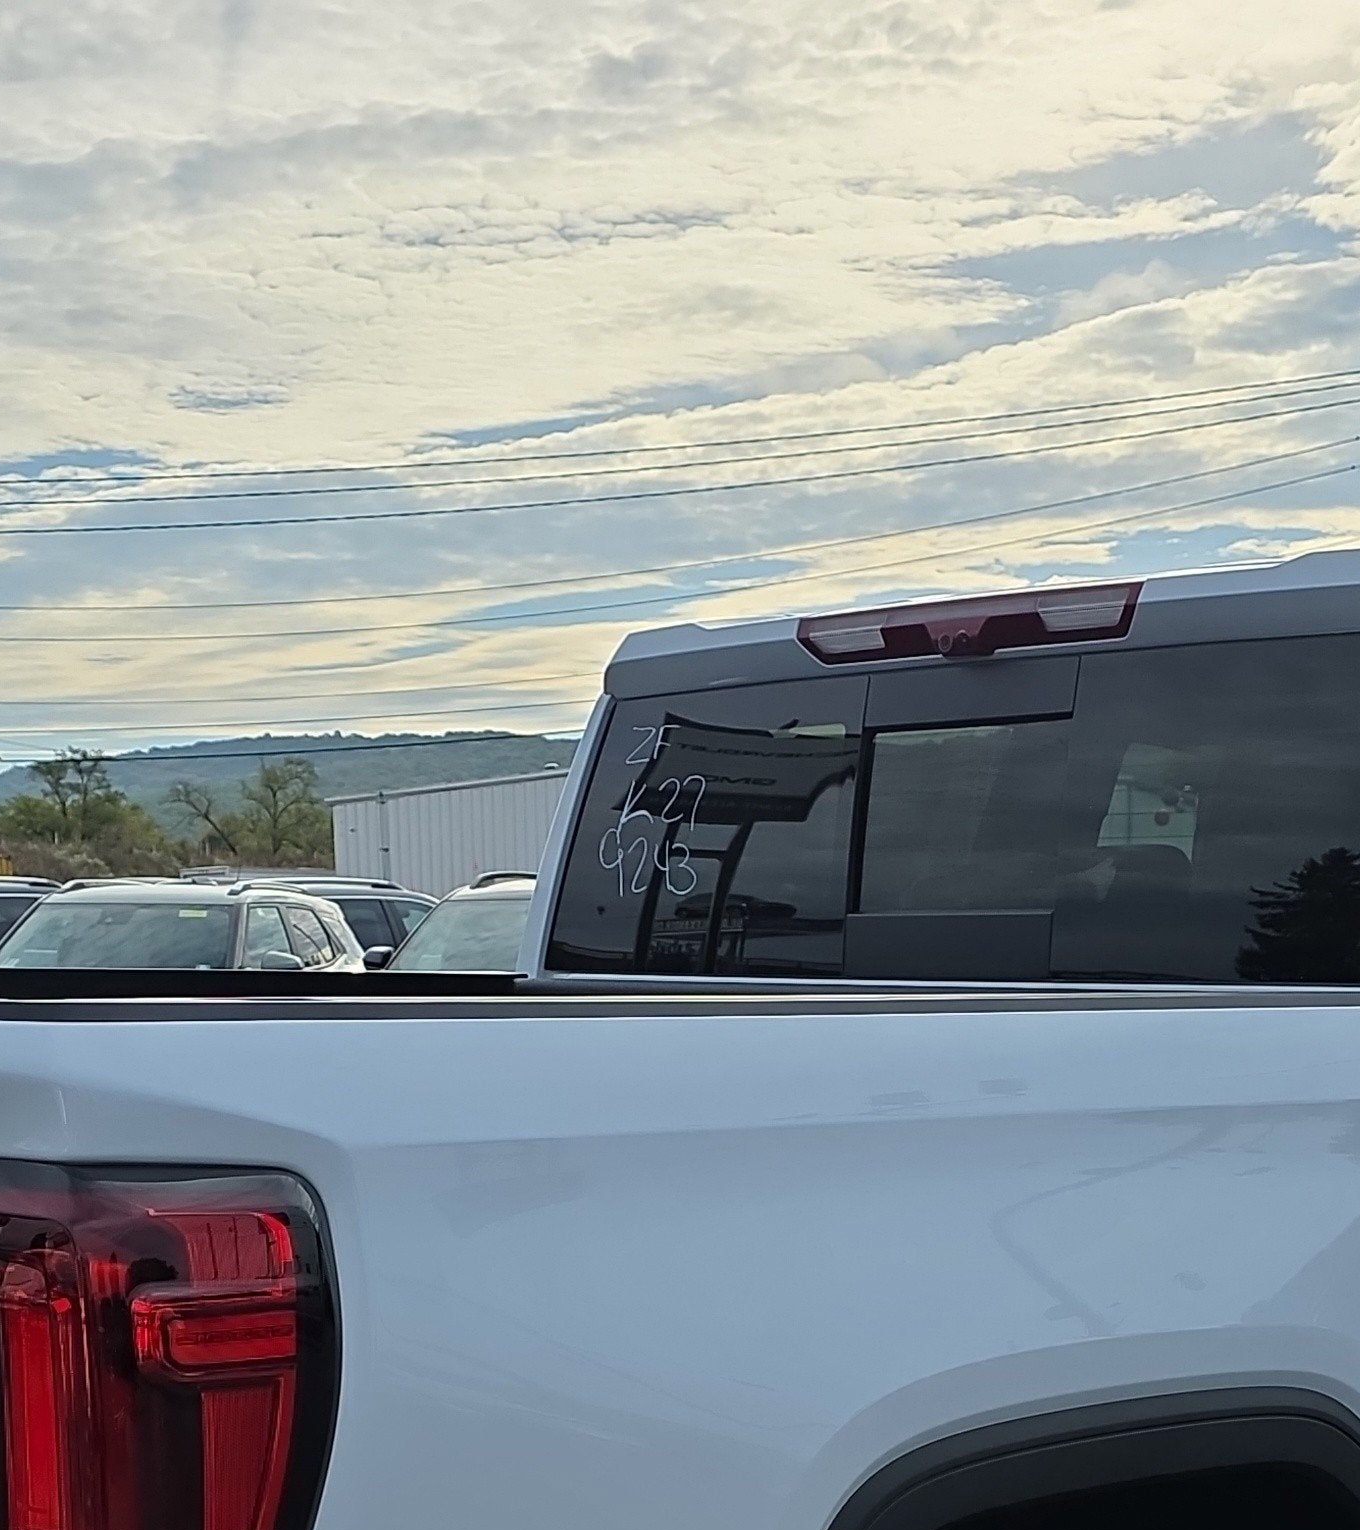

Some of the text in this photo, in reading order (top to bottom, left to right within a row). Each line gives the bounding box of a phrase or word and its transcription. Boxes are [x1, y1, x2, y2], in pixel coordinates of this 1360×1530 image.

[625, 724, 682, 765] ZF
[616, 774, 706, 833] K27
[599, 828, 697, 897] 9243
